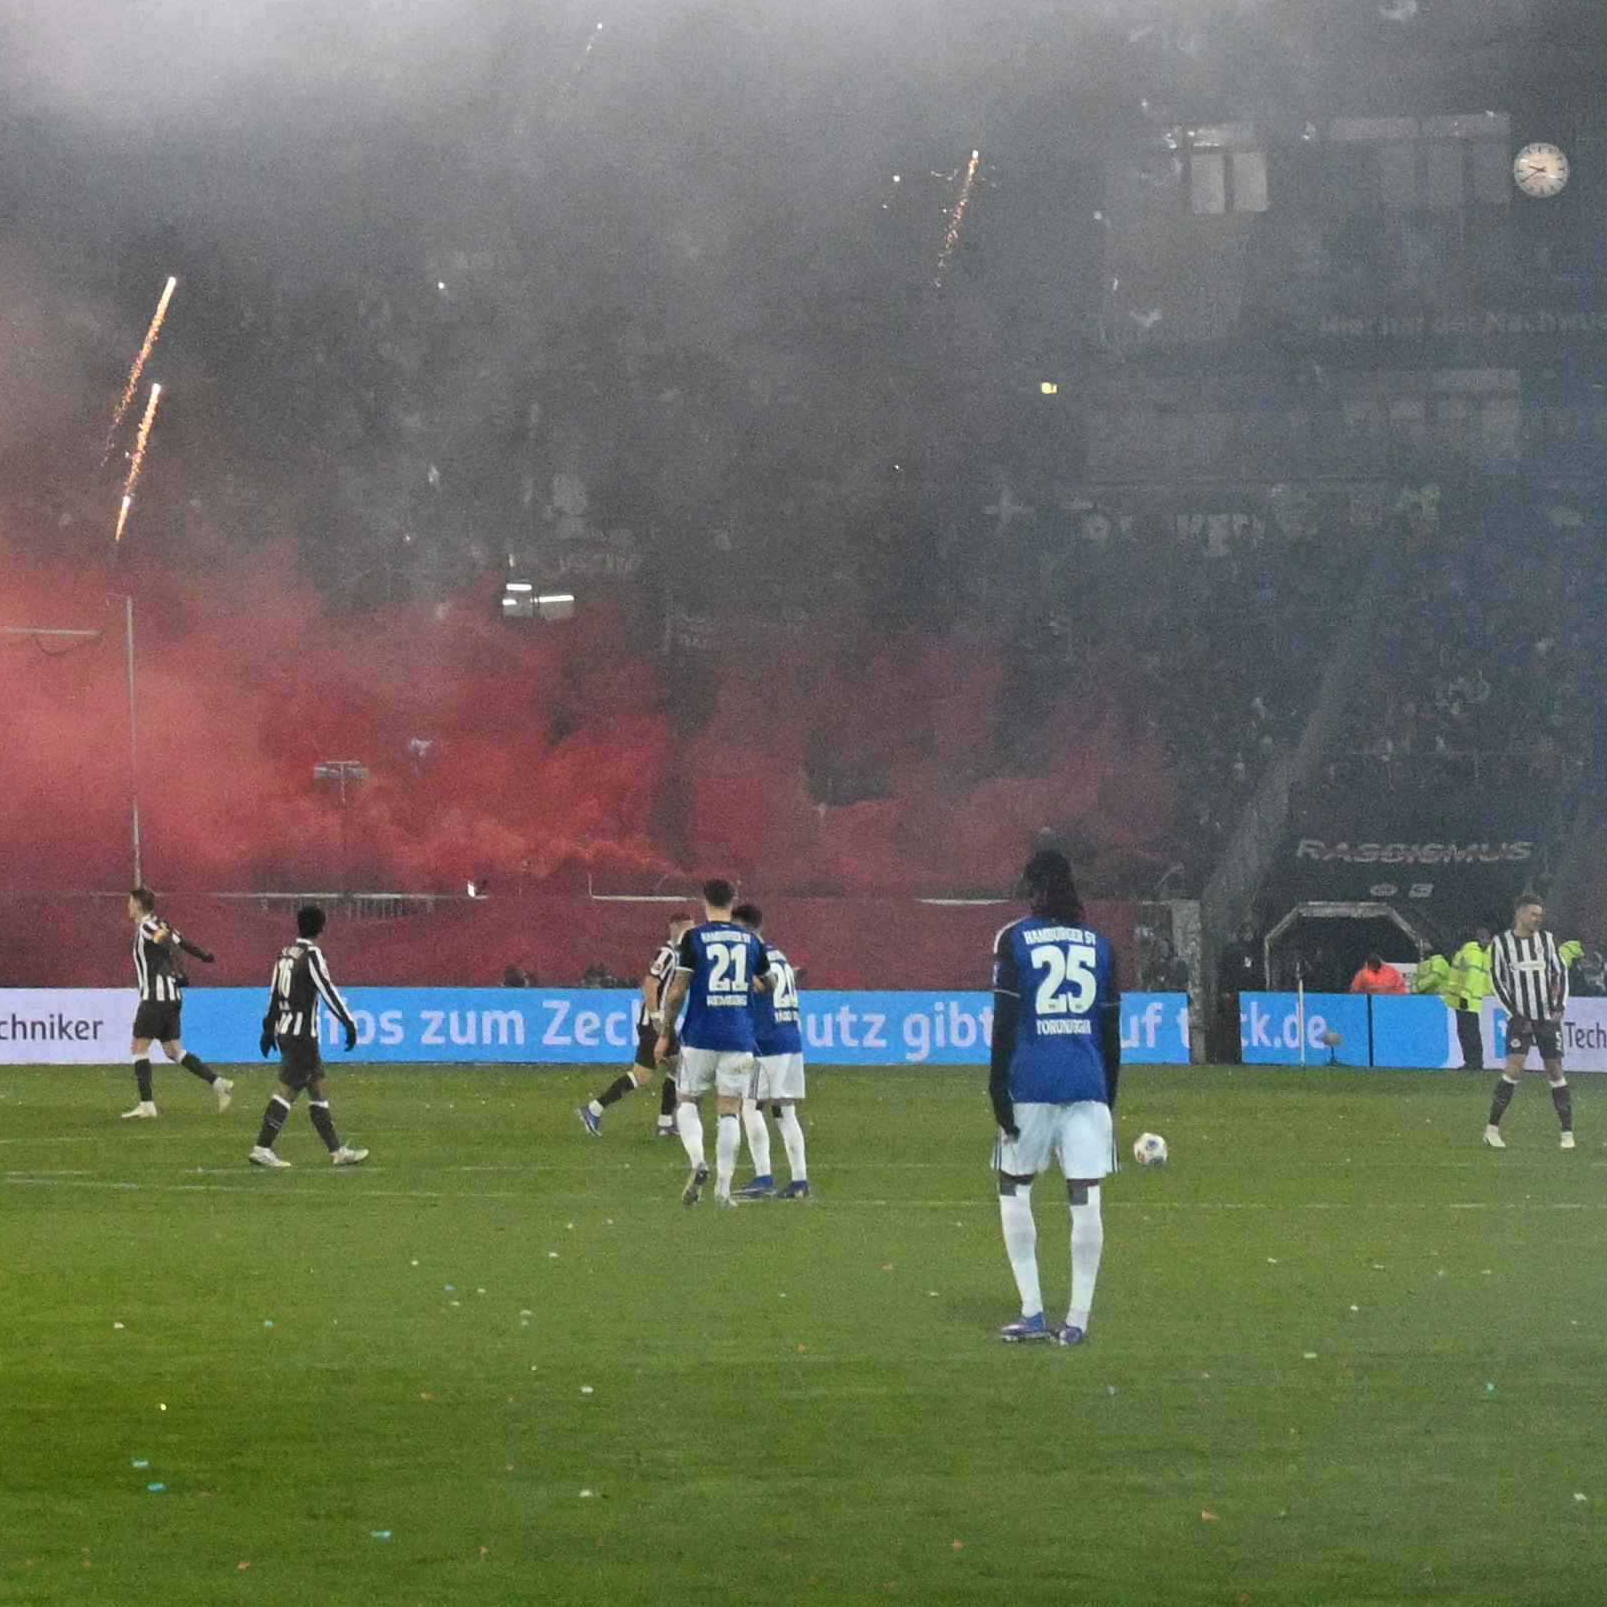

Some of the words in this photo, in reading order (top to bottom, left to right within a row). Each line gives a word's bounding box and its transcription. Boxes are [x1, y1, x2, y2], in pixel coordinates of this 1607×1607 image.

[1024, 927, 1083, 944] HAMBURGER
[706, 944, 748, 992] 21
[1031, 945, 1097, 1015] 25
[419, 1009, 524, 1046] zum
